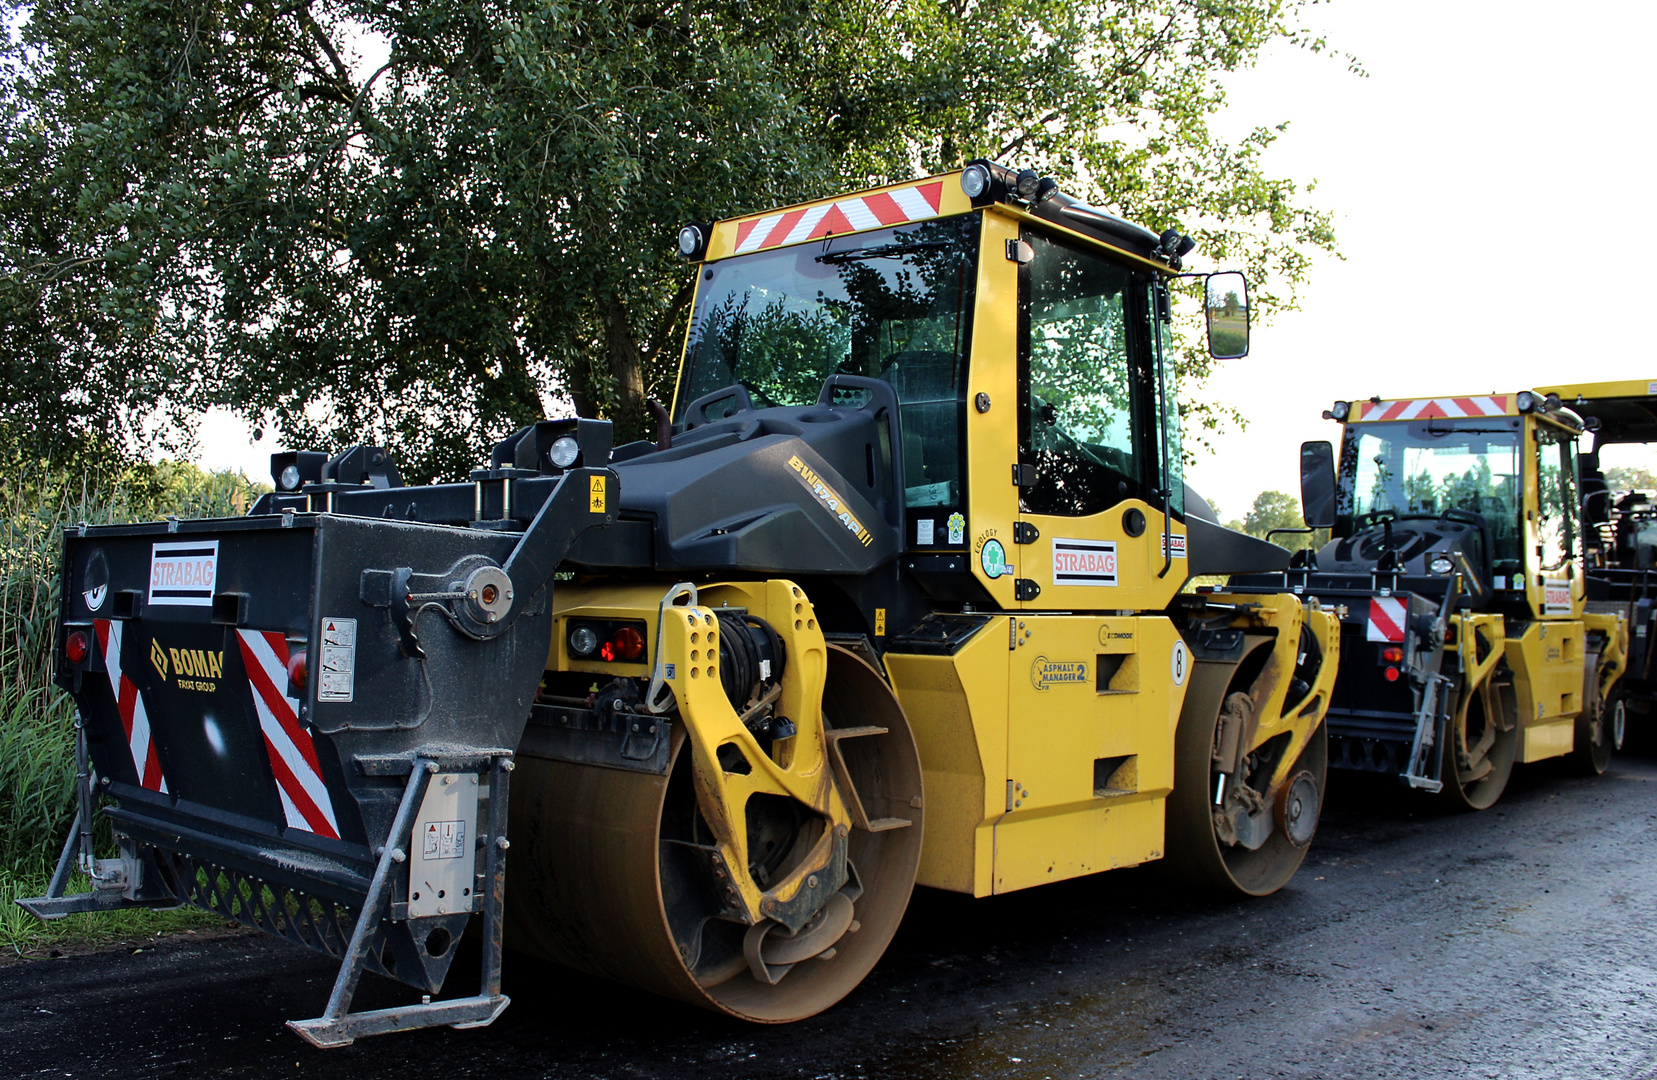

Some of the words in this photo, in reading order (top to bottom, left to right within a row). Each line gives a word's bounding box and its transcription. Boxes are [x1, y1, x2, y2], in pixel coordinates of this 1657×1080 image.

[975, 528, 998, 554] ECOLOGY
[1162, 538, 1185, 548] SABAG
[1055, 553, 1115, 573] STRABAG
[152, 560, 214, 587] STRABAG
[1043, 664, 1075, 673] ASPHALT
[1176, 648, 1182, 678] 8
[1042, 672, 1077, 682] MANAGER
[1077, 664, 1086, 681] 2
[177, 678, 195, 692] FAYAT
[195, 680, 216, 693] GROUP
